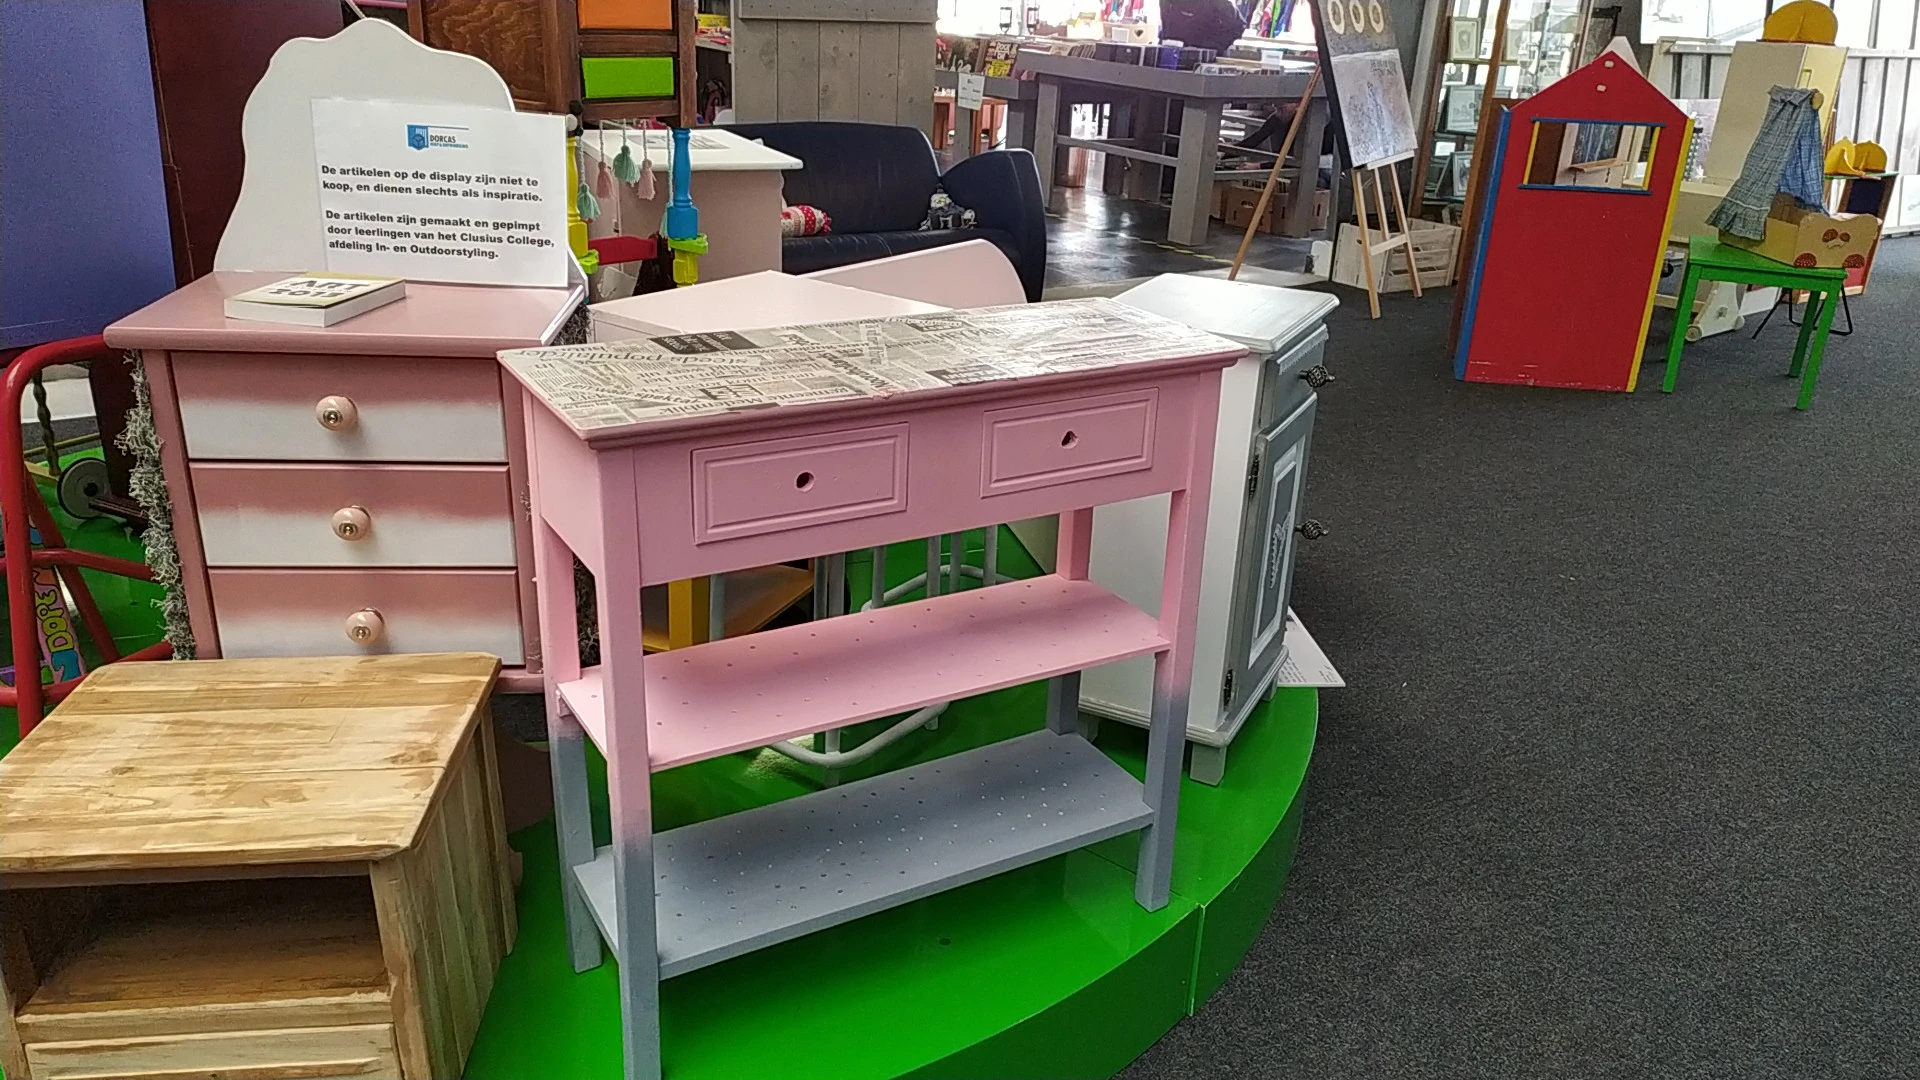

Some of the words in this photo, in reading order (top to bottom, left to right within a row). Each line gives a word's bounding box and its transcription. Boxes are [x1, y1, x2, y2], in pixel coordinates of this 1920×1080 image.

[429, 134, 457, 144] DORCAS
[321, 165, 337, 175] De
[339, 167, 391, 178] artikelen
[394, 170, 408, 180] op
[412, 170, 426, 180] de
[429, 171, 472, 184] display
[475, 174, 496, 186] zijn
[499, 176, 523, 186] niet
[526, 177, 539, 187] te
[322, 181, 353, 192] koop,
[356, 184, 370, 192] en
[373, 183, 412, 194] dienen
[415, 186, 459, 196] slechts
[461, 188, 479, 198] als
[482, 189, 543, 202] inspiratie.
[325, 210, 340, 220] De
[343, 212, 394, 223] artikelen
[396, 214, 417, 225] zijn
[420, 217, 471, 227] gemaakt
[474, 219, 489, 227] en
[492, 221, 541, 232] gepimpt
[327, 226, 352, 235] door
[355, 227, 411, 239] leerlingen
[414, 232, 435, 240] van
[438, 231, 457, 241] het
[460, 233, 504, 243] Clusius
[506, 235, 555, 248] College,
[329, 240, 373, 252] afdeling
[376, 242, 390, 252] In-
[393, 245, 407, 253] en
[410, 244, 499, 260] Outdoorstyling.
[290, 280, 370, 290] ART
[515, 350, 663, 362] populairder
[670, 356, 748, 364] steeds
[767, 387, 849, 401] gemeente
[35, 589, 75, 653] DOPE
